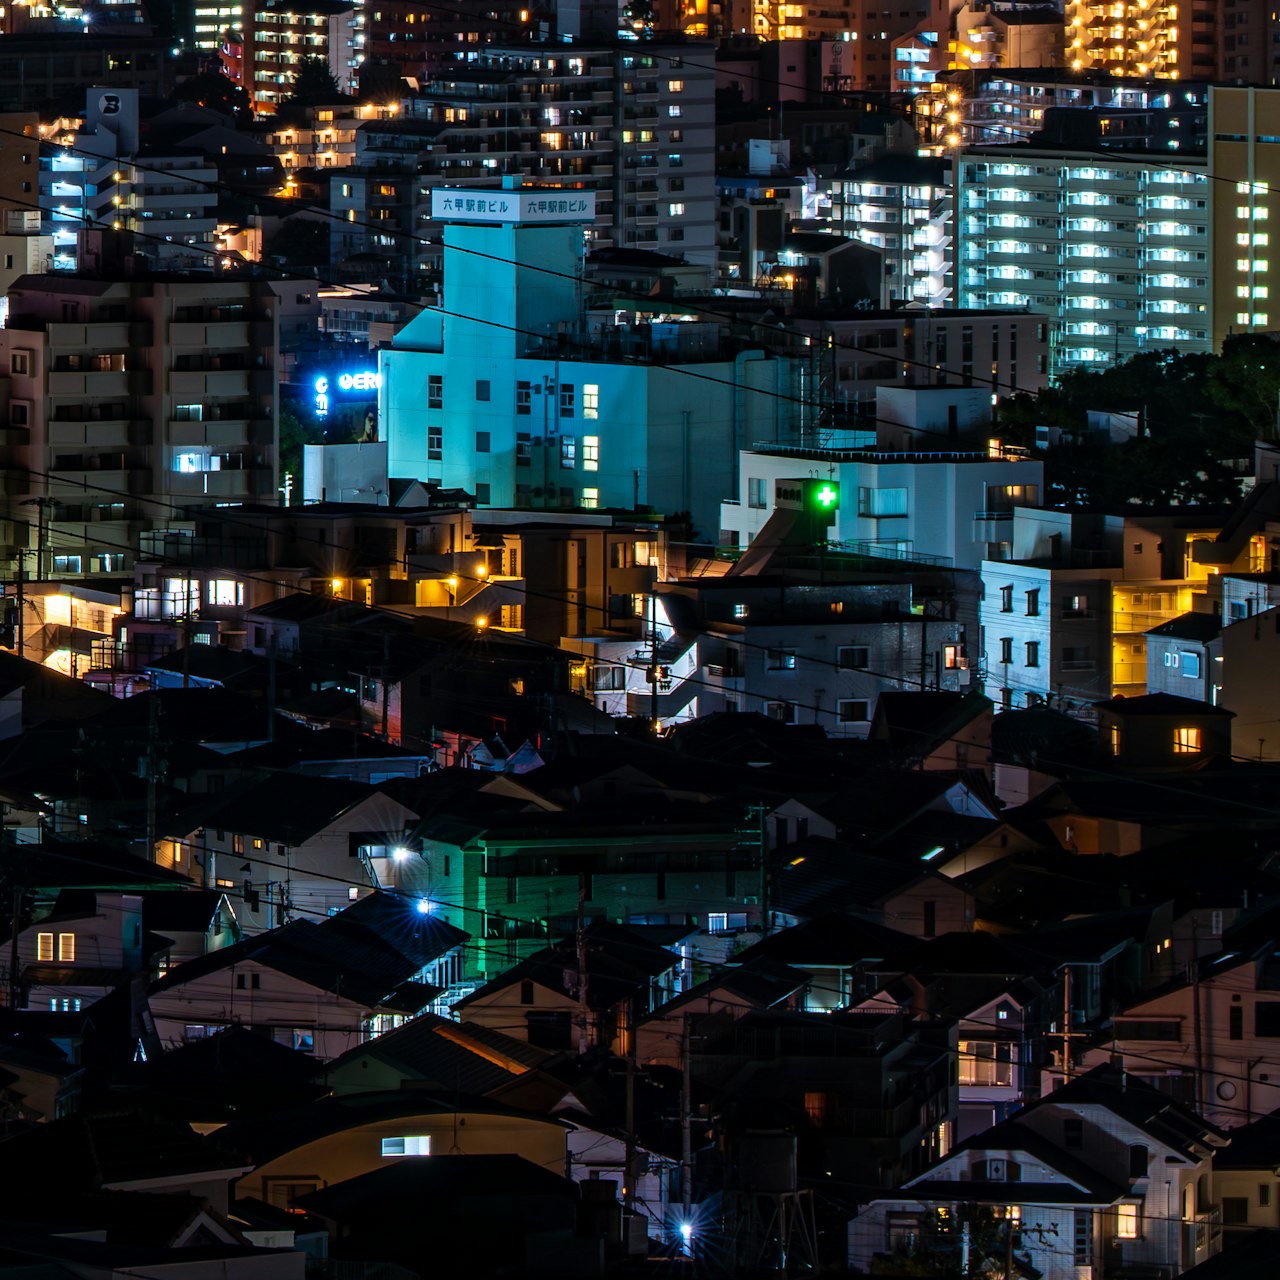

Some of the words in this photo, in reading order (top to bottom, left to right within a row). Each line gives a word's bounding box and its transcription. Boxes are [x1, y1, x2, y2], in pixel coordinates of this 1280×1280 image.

[443, 197, 508, 213] 六甲駅前ビル
[527, 199, 588, 214] 六甲駅前ビル
